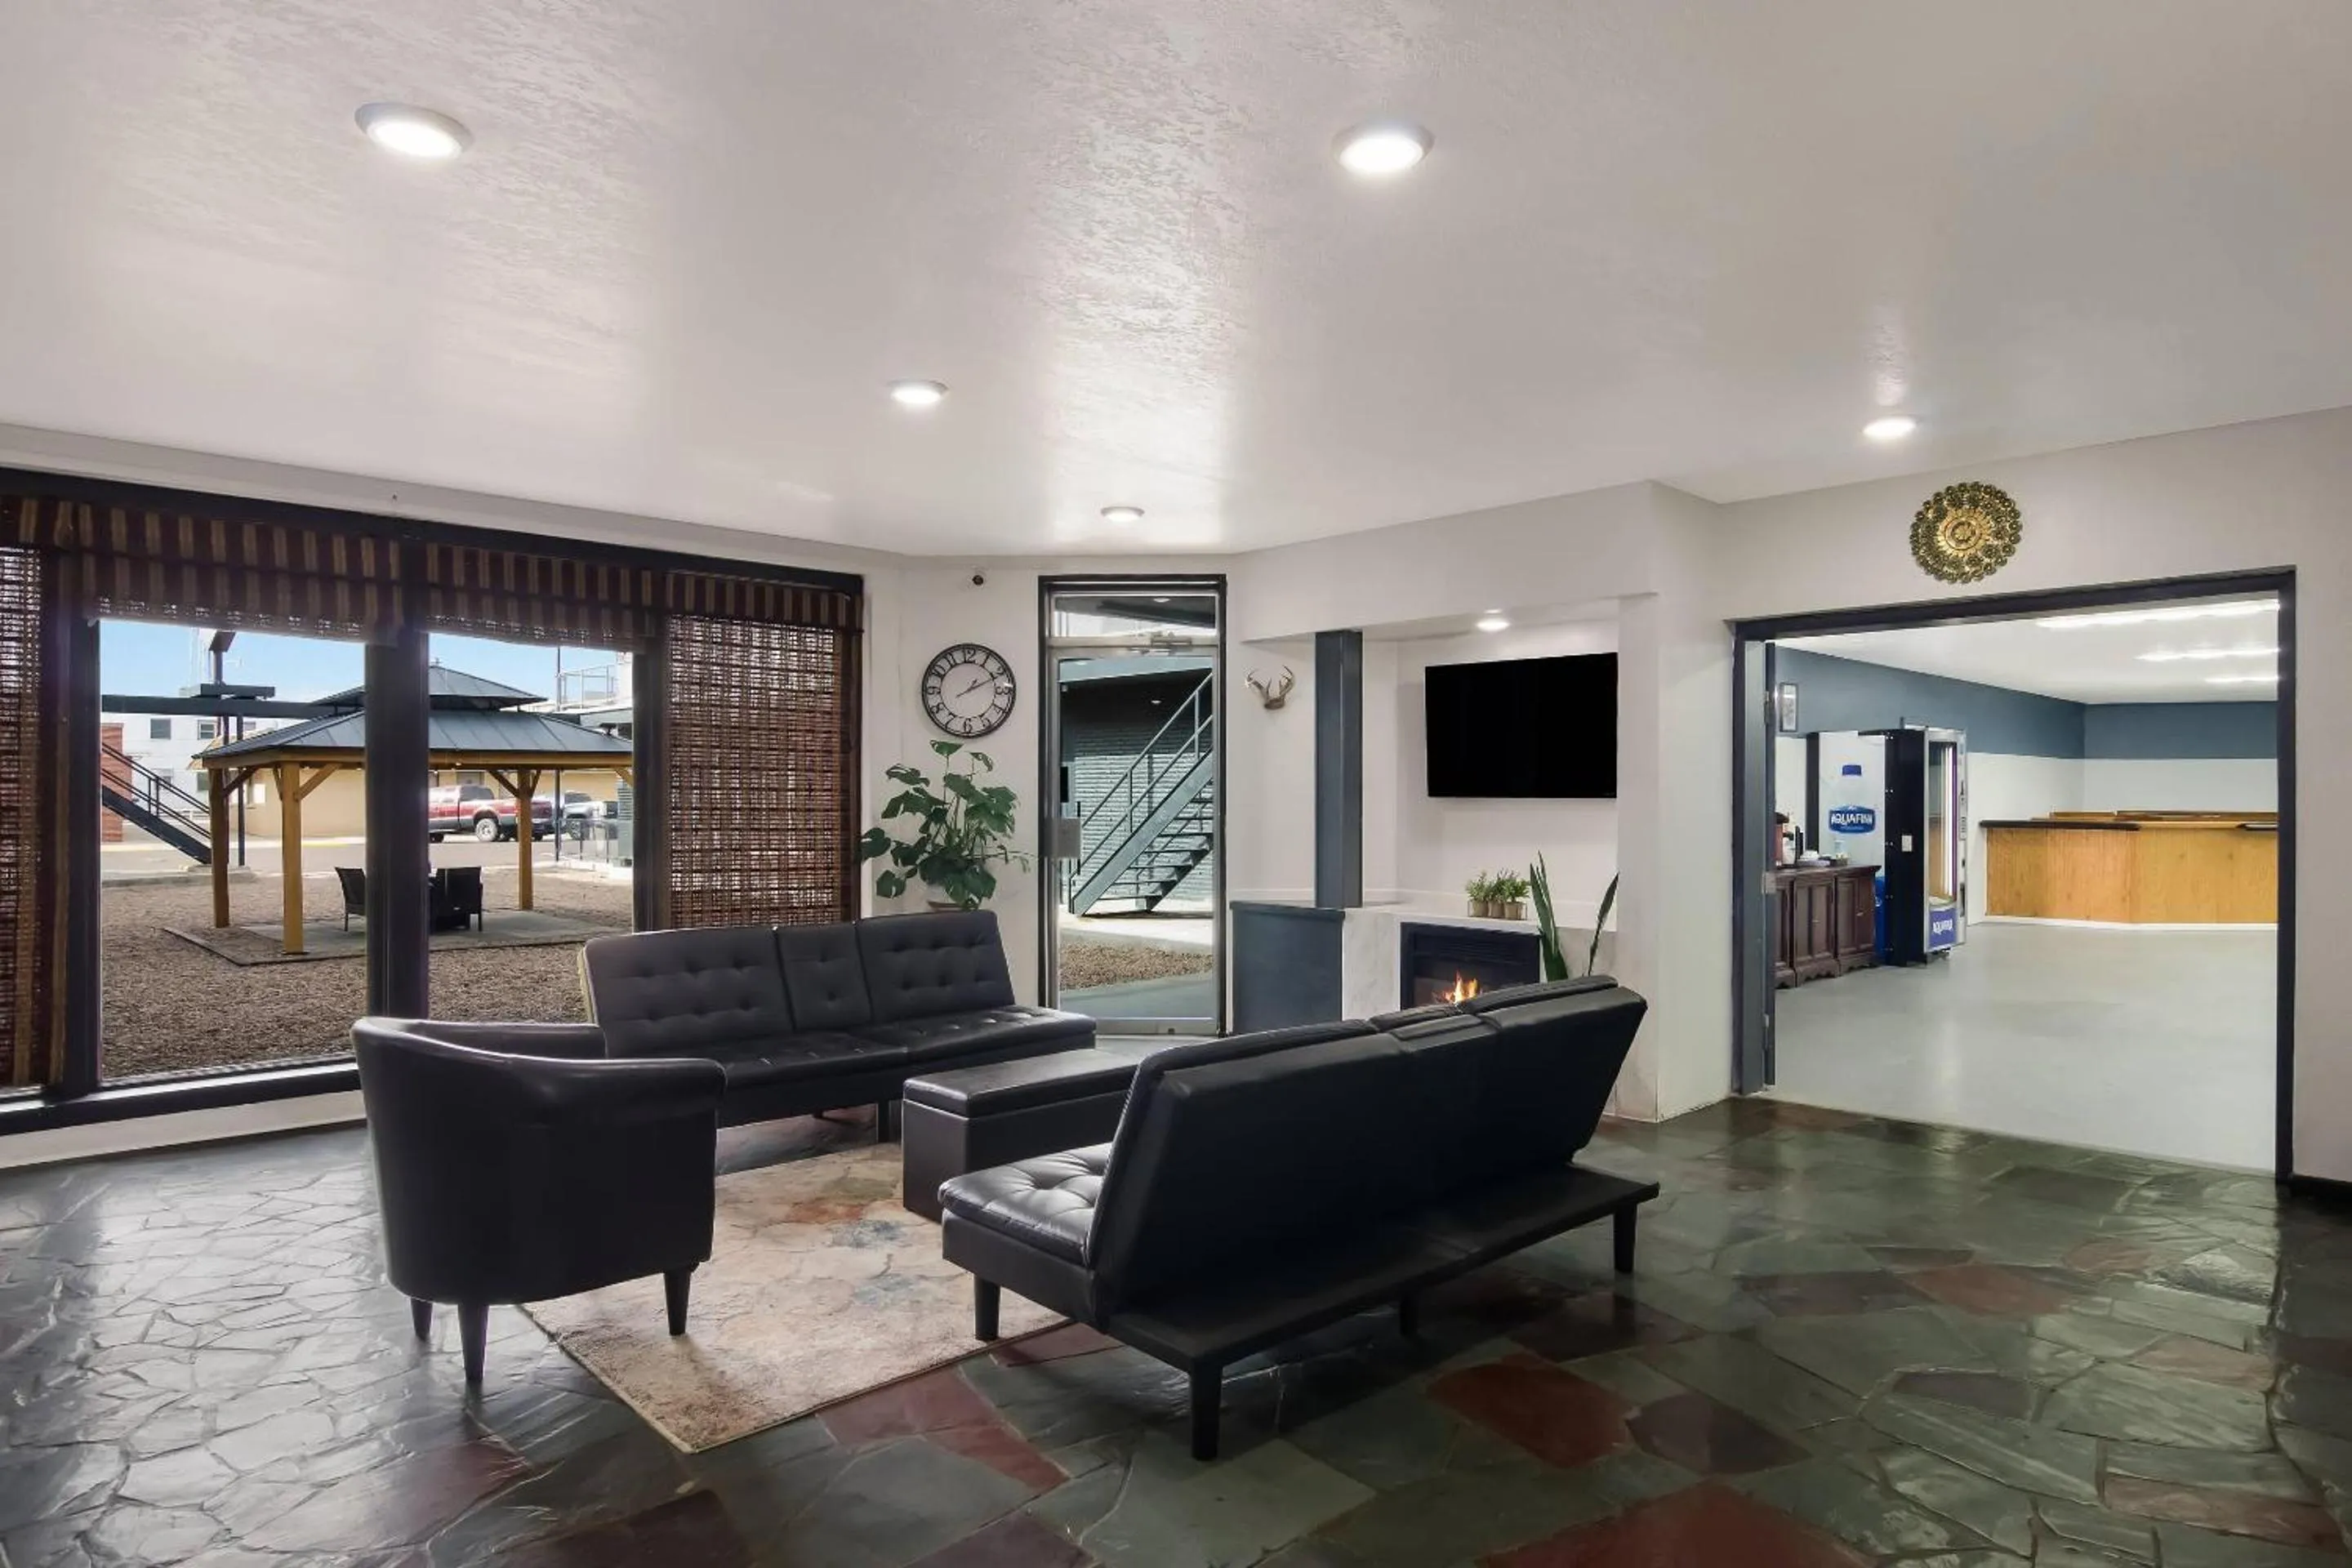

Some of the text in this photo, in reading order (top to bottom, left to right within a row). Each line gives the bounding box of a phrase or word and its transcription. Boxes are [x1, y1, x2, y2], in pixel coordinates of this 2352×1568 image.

[942, 652, 956, 668] 11
[962, 648, 976, 663] 12
[980, 653, 991, 667] 1
[929, 664, 946, 679] 10
[990, 666, 1005, 680] 2
[926, 685, 941, 695] 9
[996, 686, 1011, 695] 3
[930, 702, 943, 715] 8
[992, 703, 1007, 715] 4
[945, 712, 957, 729] 7
[963, 718, 973, 733] 6
[979, 715, 992, 729] 5
